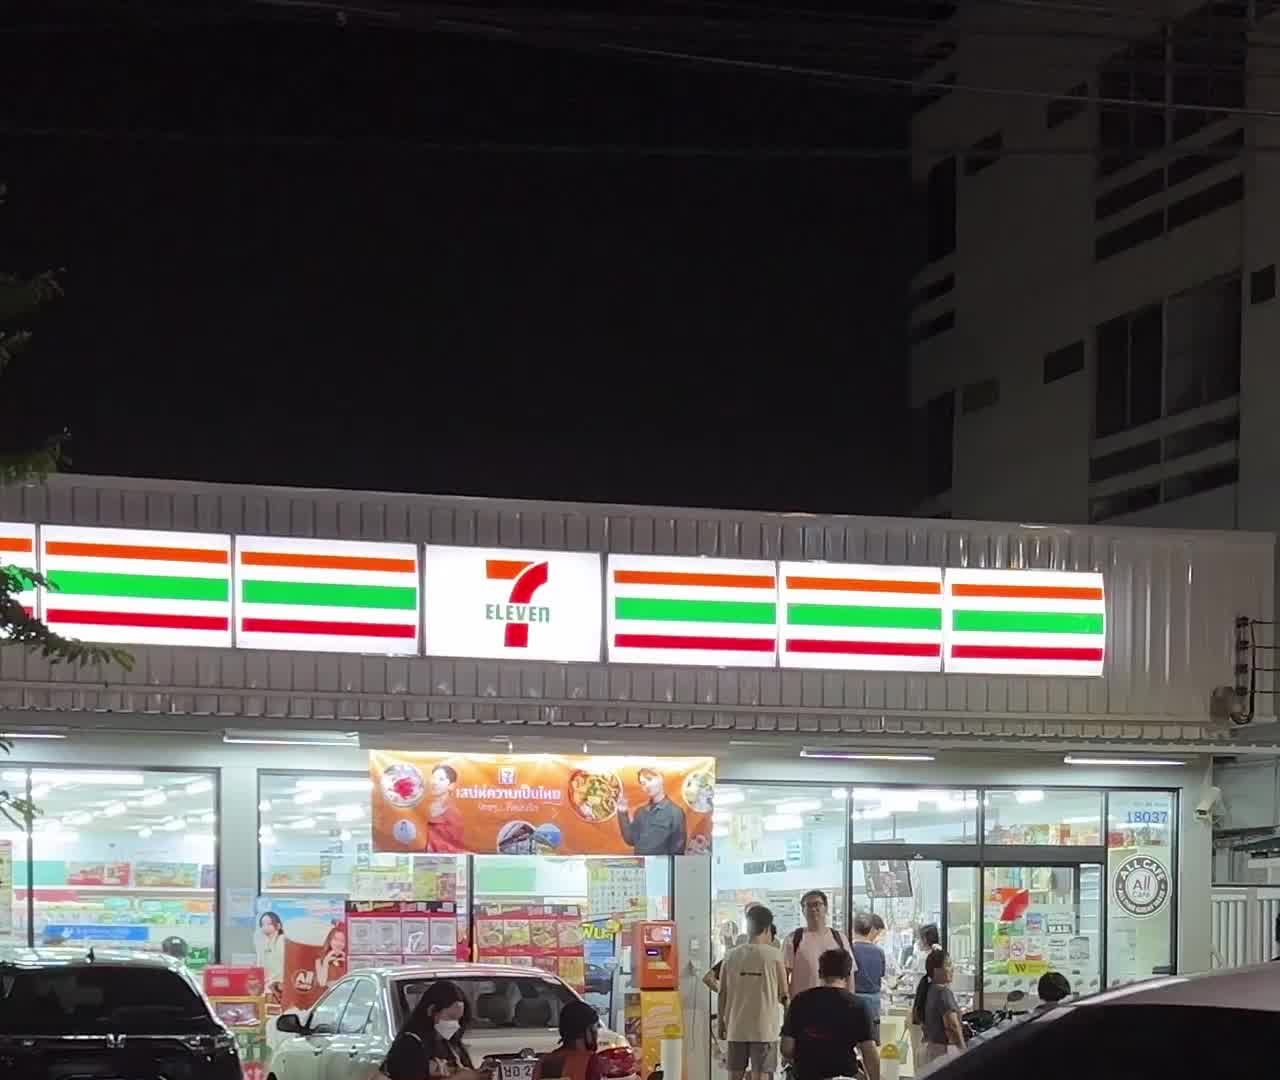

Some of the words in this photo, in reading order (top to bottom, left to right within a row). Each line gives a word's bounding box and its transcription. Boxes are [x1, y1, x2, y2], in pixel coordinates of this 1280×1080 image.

[485, 559, 549, 648] 7
[1127, 811, 1169, 824] 18037
[1120, 860, 1141, 881] ALL
[1133, 875, 1151, 891] All
